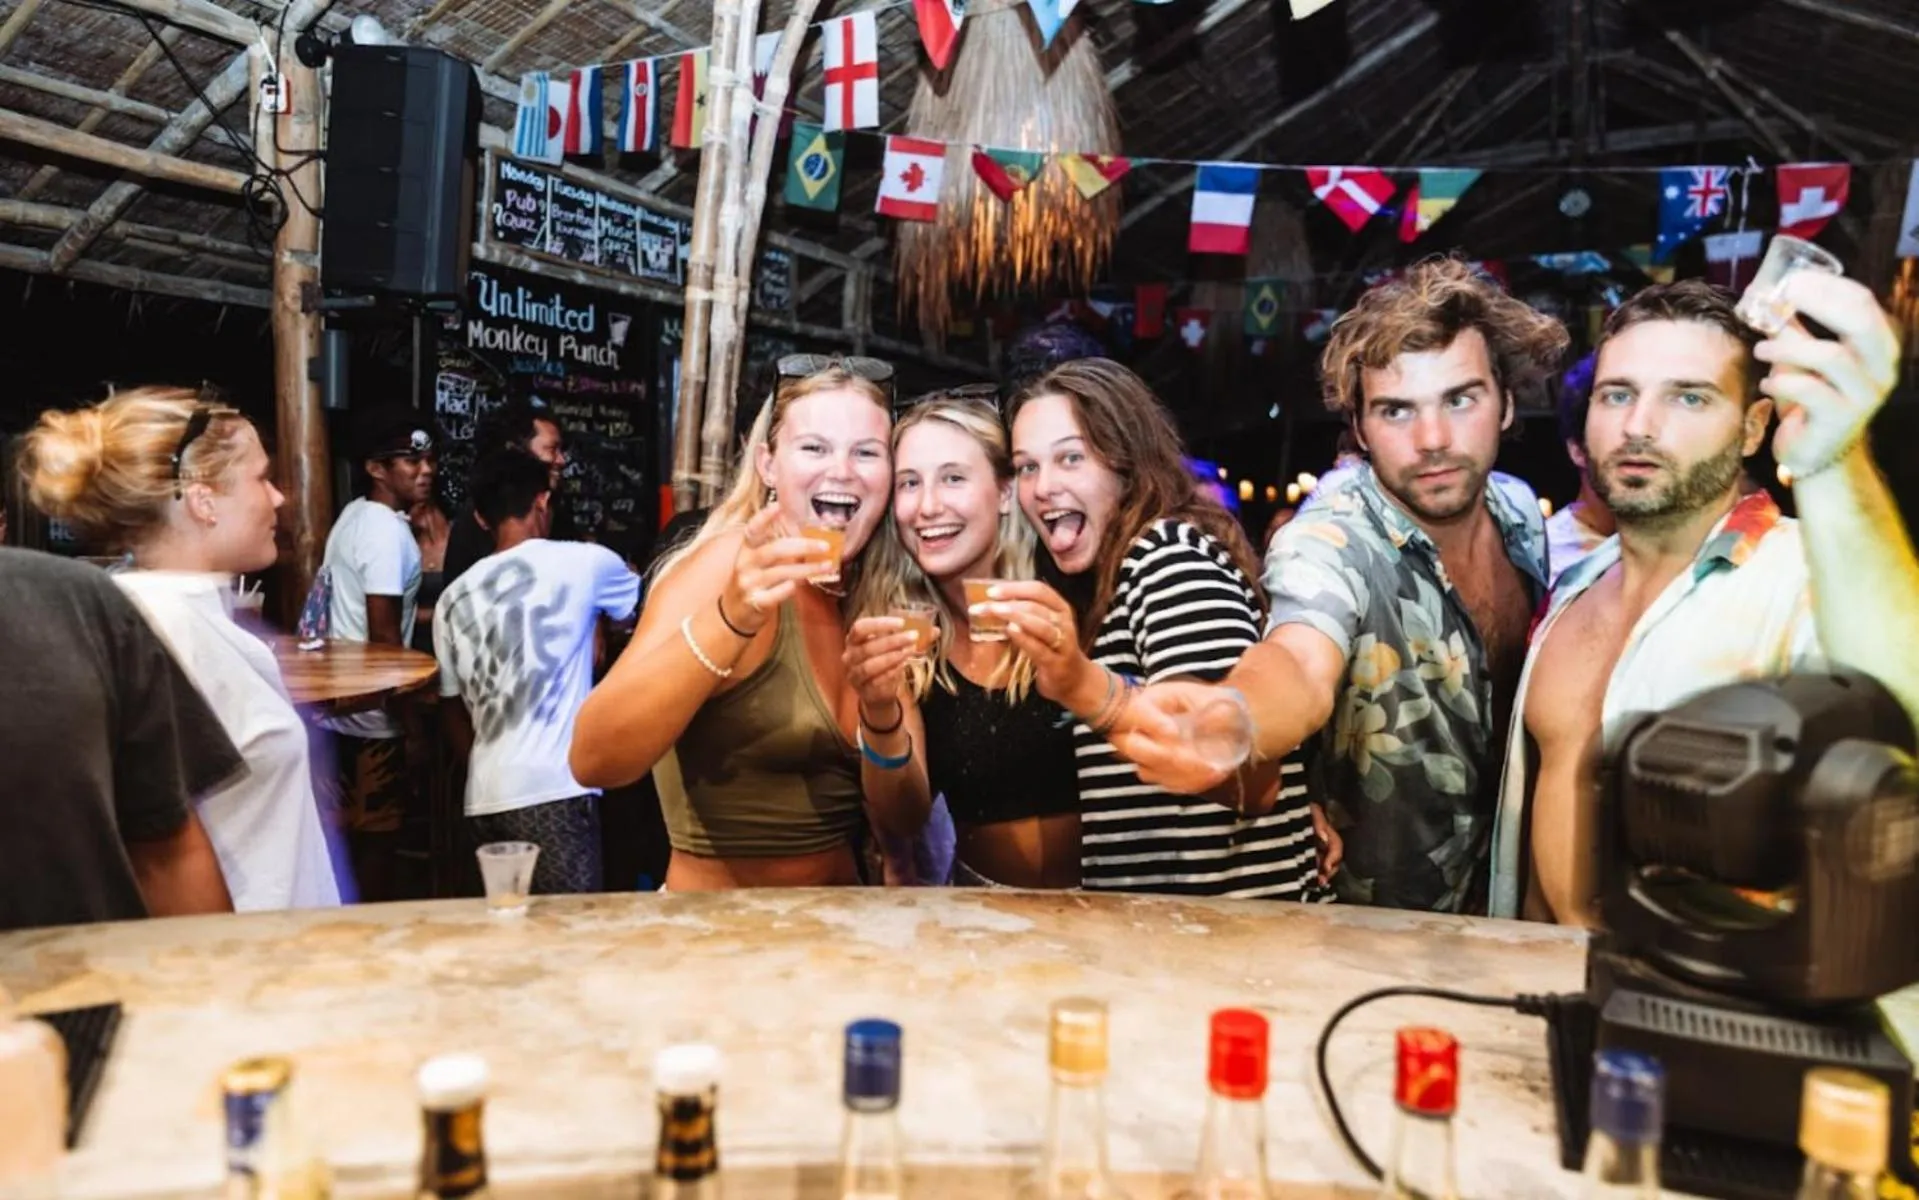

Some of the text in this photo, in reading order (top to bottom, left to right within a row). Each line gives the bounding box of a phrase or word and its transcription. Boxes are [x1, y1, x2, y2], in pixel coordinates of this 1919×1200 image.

[505, 188, 537, 213] Pub
[471, 271, 595, 333] Unlimited
[467, 318, 548, 363] Monkey
[559, 332, 620, 371] Punch
